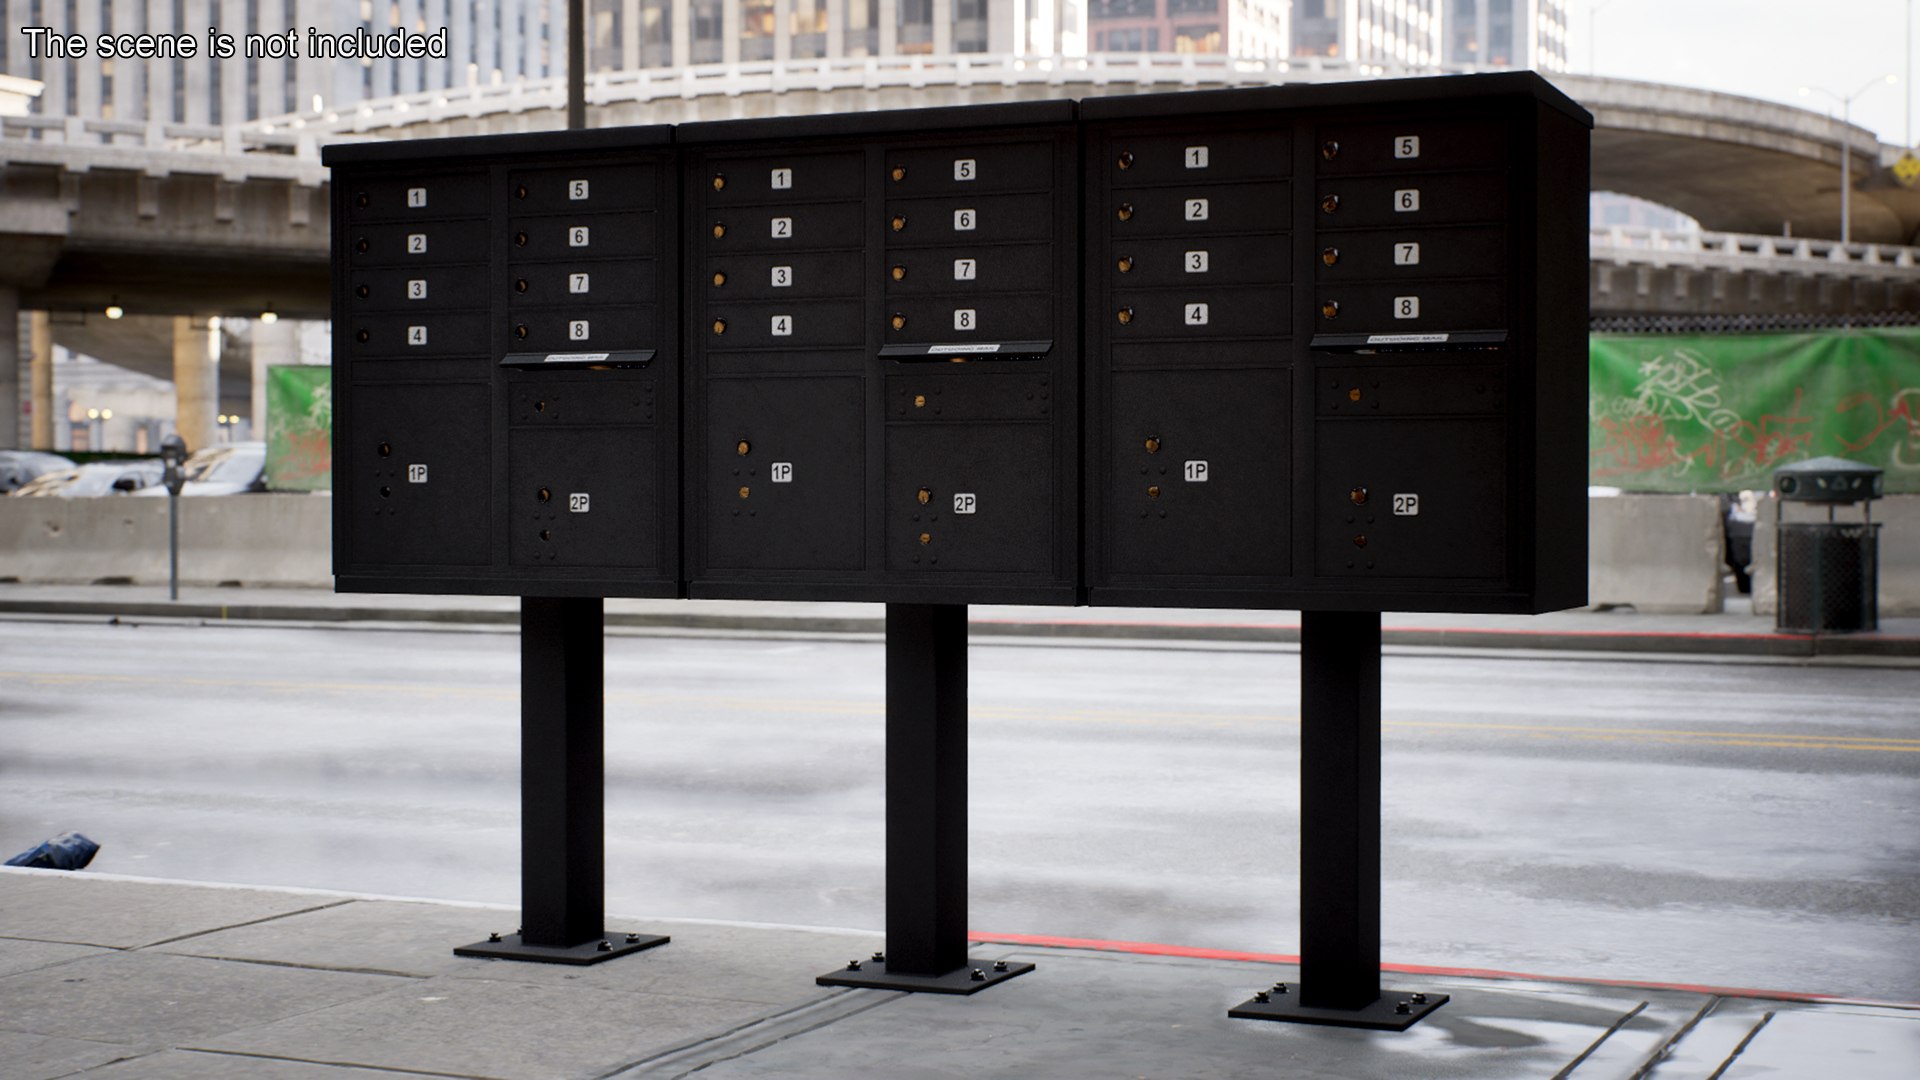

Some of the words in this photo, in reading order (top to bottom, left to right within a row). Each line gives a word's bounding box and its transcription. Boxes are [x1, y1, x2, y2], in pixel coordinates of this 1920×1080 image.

[1401, 138, 1413, 156] 5
[1191, 149, 1201, 166] 1
[960, 162, 970, 178] 5
[776, 171, 785, 186] 1
[412, 190, 421, 205] 1
[575, 182, 585, 198] 5
[1401, 192, 1413, 209] 6
[1192, 201, 1203, 218] 2
[777, 220, 787, 236] 2
[960, 212, 970, 228] 6
[413, 236, 422, 251] 2
[574, 229, 584, 244] 6
[1191, 253, 1202, 270] 3
[1402, 245, 1414, 262] 7
[777, 269, 786, 284] 3
[961, 261, 971, 277] 7
[413, 282, 422, 297] 3
[575, 276, 585, 291] 7
[1191, 306, 1202, 322] 4
[1401, 299, 1412, 316] 8
[776, 318, 787, 333] 4
[960, 312, 970, 328] 8
[413, 328, 422, 342] 4
[575, 323, 584, 338] 8
[410, 466, 426, 481] 1P
[773, 464, 791, 480] 1P
[1186, 463, 1207, 479] 1P
[570, 495, 588, 511] 2P
[955, 496, 975, 512] 2P
[1394, 496, 1417, 513] 2P
